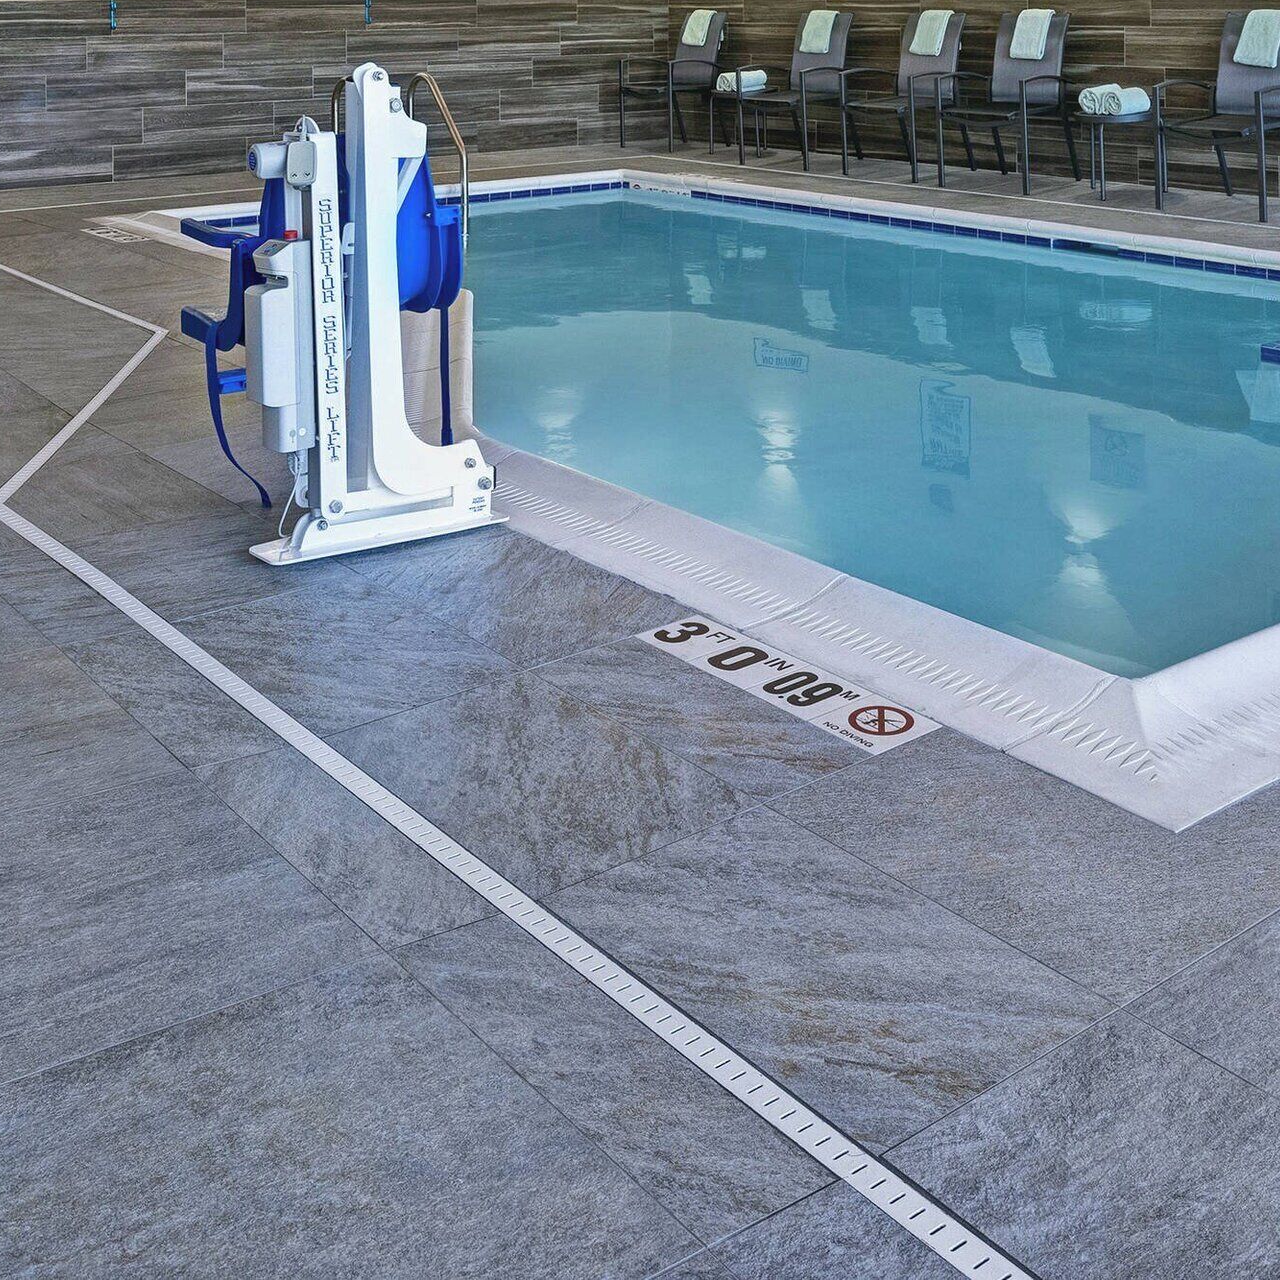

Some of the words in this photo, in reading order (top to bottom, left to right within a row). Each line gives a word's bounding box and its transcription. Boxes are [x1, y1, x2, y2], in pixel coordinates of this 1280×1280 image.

[319, 198, 336, 304] SUPERIOR
[323, 315, 340, 395] SERIES
[326, 407, 341, 459] LIFT
[653, 621, 710, 644] 3
[705, 631, 736, 644] FT
[707, 646, 769, 671] 0
[763, 657, 794, 671] IN
[839, 690, 860, 701] M
[822, 721, 840, 733] NO
[838, 729, 874, 748] DIVING
